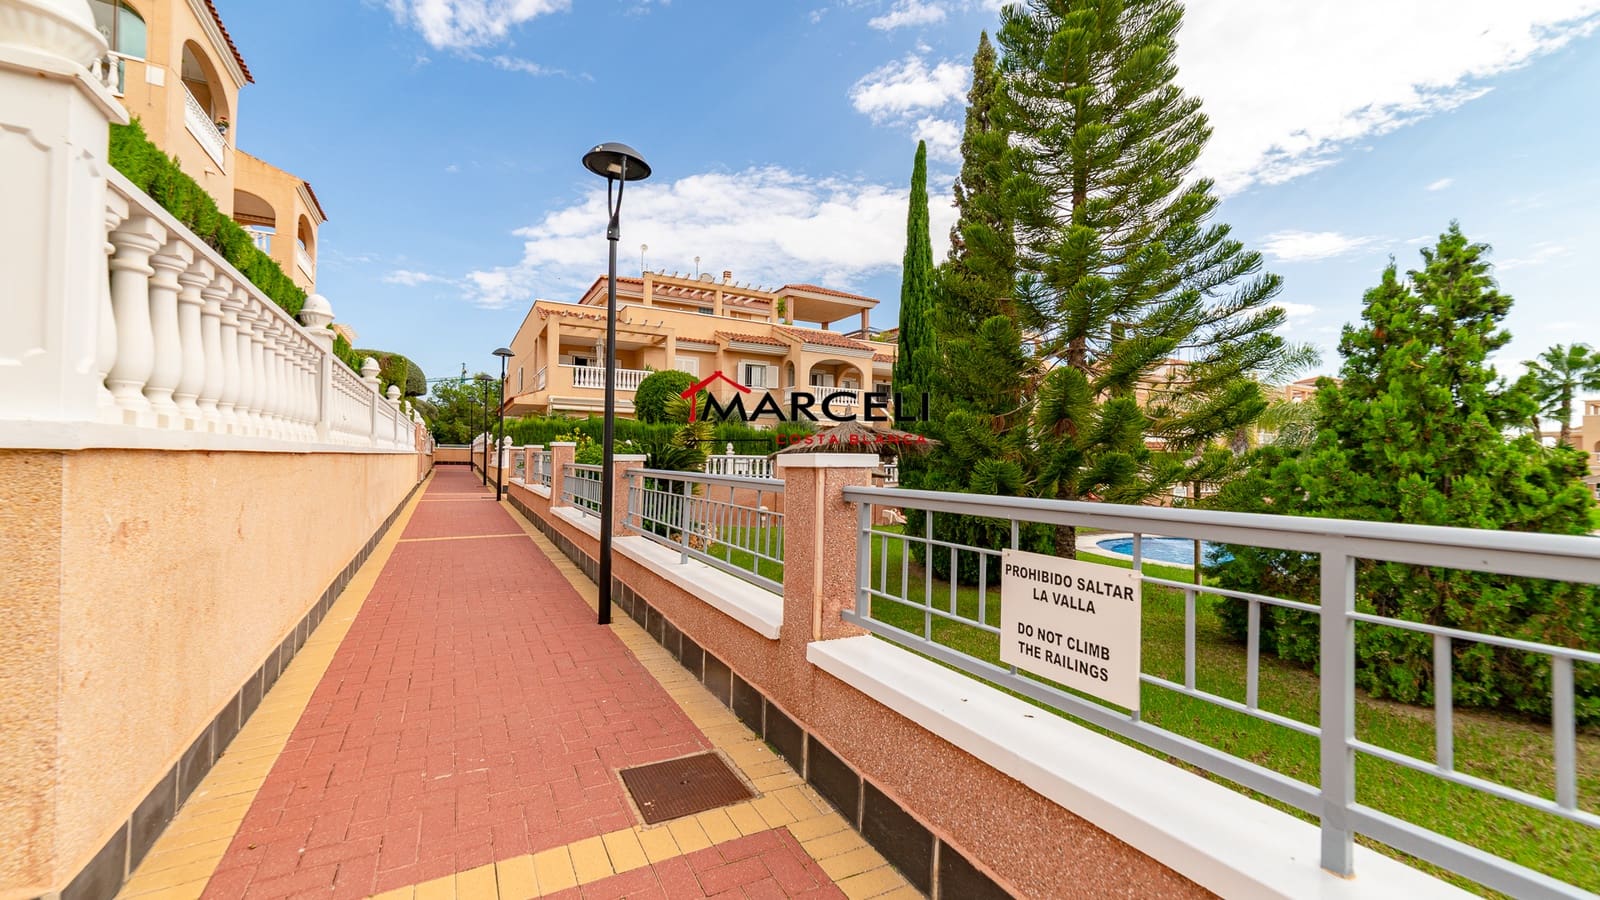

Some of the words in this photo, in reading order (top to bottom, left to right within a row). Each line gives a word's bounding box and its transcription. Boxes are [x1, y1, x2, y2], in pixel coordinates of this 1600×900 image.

[1005, 563, 1072, 588] PROHIBIDO
[1077, 577, 1134, 601] SALTAR
[1033, 587, 1048, 603] LA
[1052, 591, 1096, 614] VALLA
[1017, 622, 1033, 637] DO
[1037, 627, 1063, 646] NOT
[1067, 637, 1110, 661] CLIMB
[1018, 641, 1041, 659] THE
[1045, 650, 1109, 682] RAILINGS
